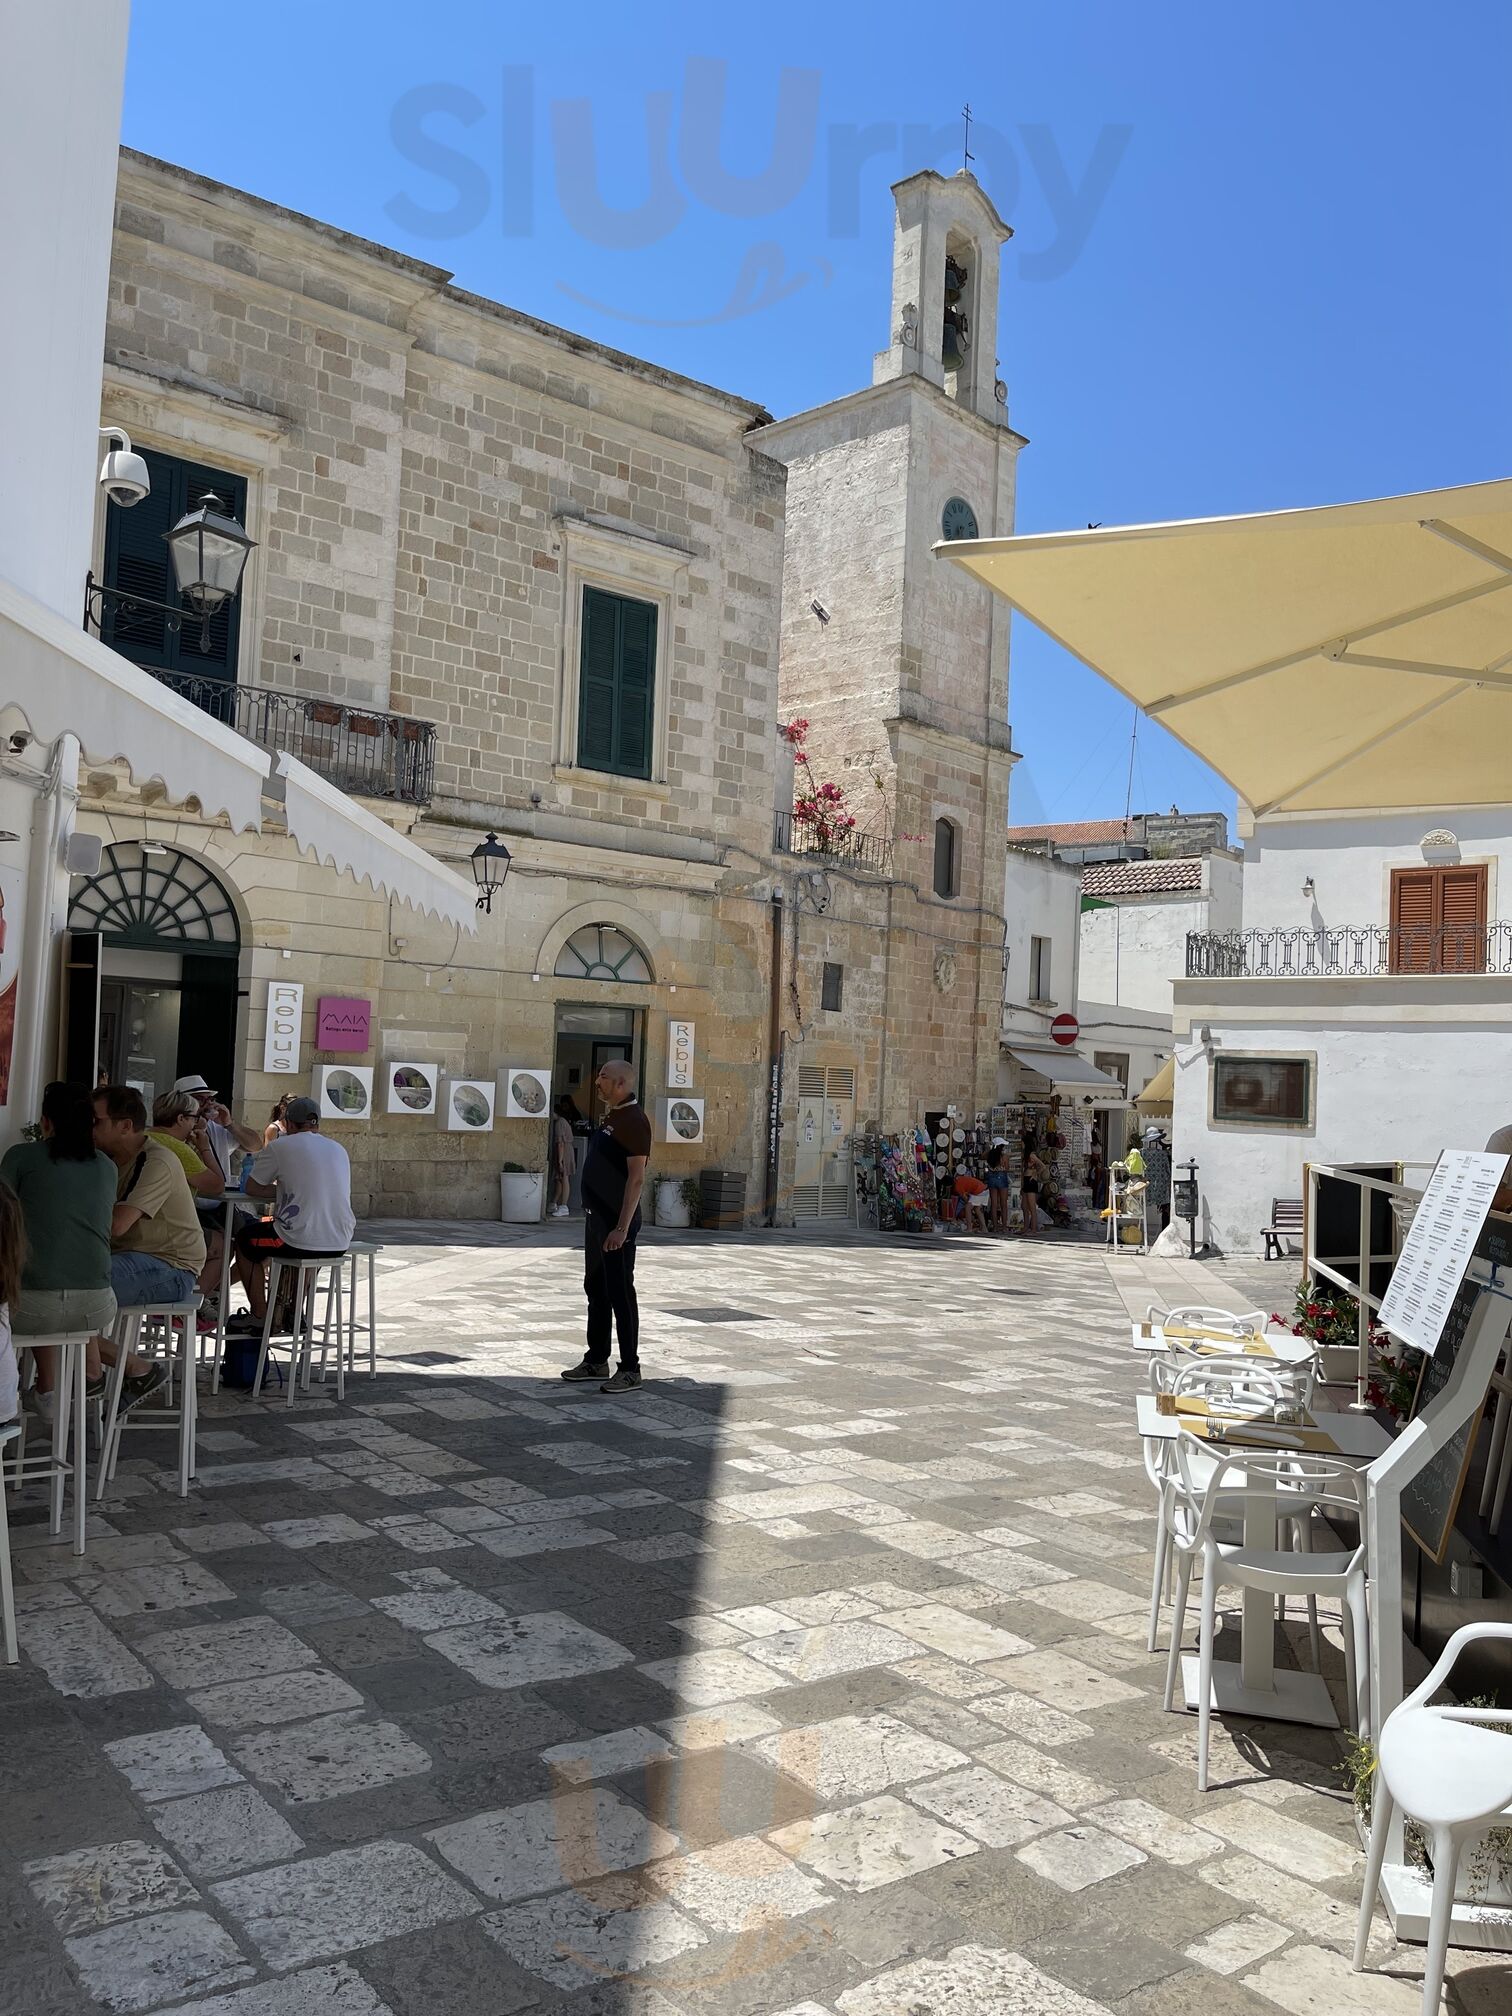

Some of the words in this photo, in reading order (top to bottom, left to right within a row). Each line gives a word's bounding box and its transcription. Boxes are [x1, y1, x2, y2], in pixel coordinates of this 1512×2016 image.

[273, 988, 297, 1069] Rebus
[322, 1013, 368, 1026] MAIA
[675, 1024, 689, 1085] Rebus
